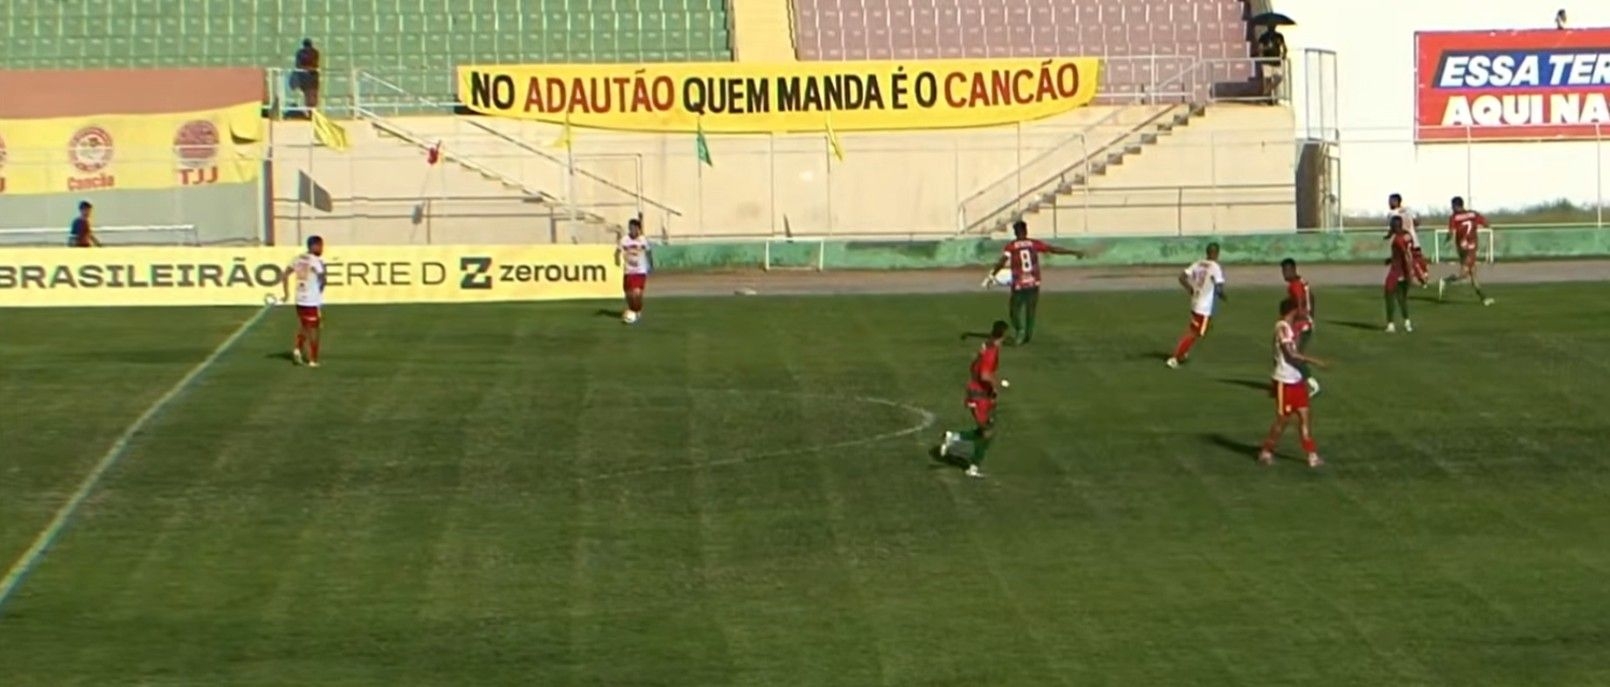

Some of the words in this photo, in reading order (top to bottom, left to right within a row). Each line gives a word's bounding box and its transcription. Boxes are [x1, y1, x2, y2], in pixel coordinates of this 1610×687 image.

[1440, 54, 1540, 87] ESSA
[1549, 53, 1610, 85] TER
[471, 71, 515, 110] NO
[523, 68, 675, 113] ADAUTÃO
[682, 77, 769, 115] QUEM
[777, 73, 885, 111] MANDA
[891, 66, 908, 109] É
[914, 71, 937, 109] O
[944, 59, 1079, 108] CANCÃO
[1440, 94, 1544, 127] AQUI
[1550, 93, 1610, 125] NA
[1462, 220, 1472, 234] 7
[0, 257, 284, 288] BRASILEIRÃO
[324, 257, 411, 286] ÉRIE
[422, 262, 446, 286] D
[500, 262, 607, 284] zeroum
[1020, 249, 1033, 272] 8
